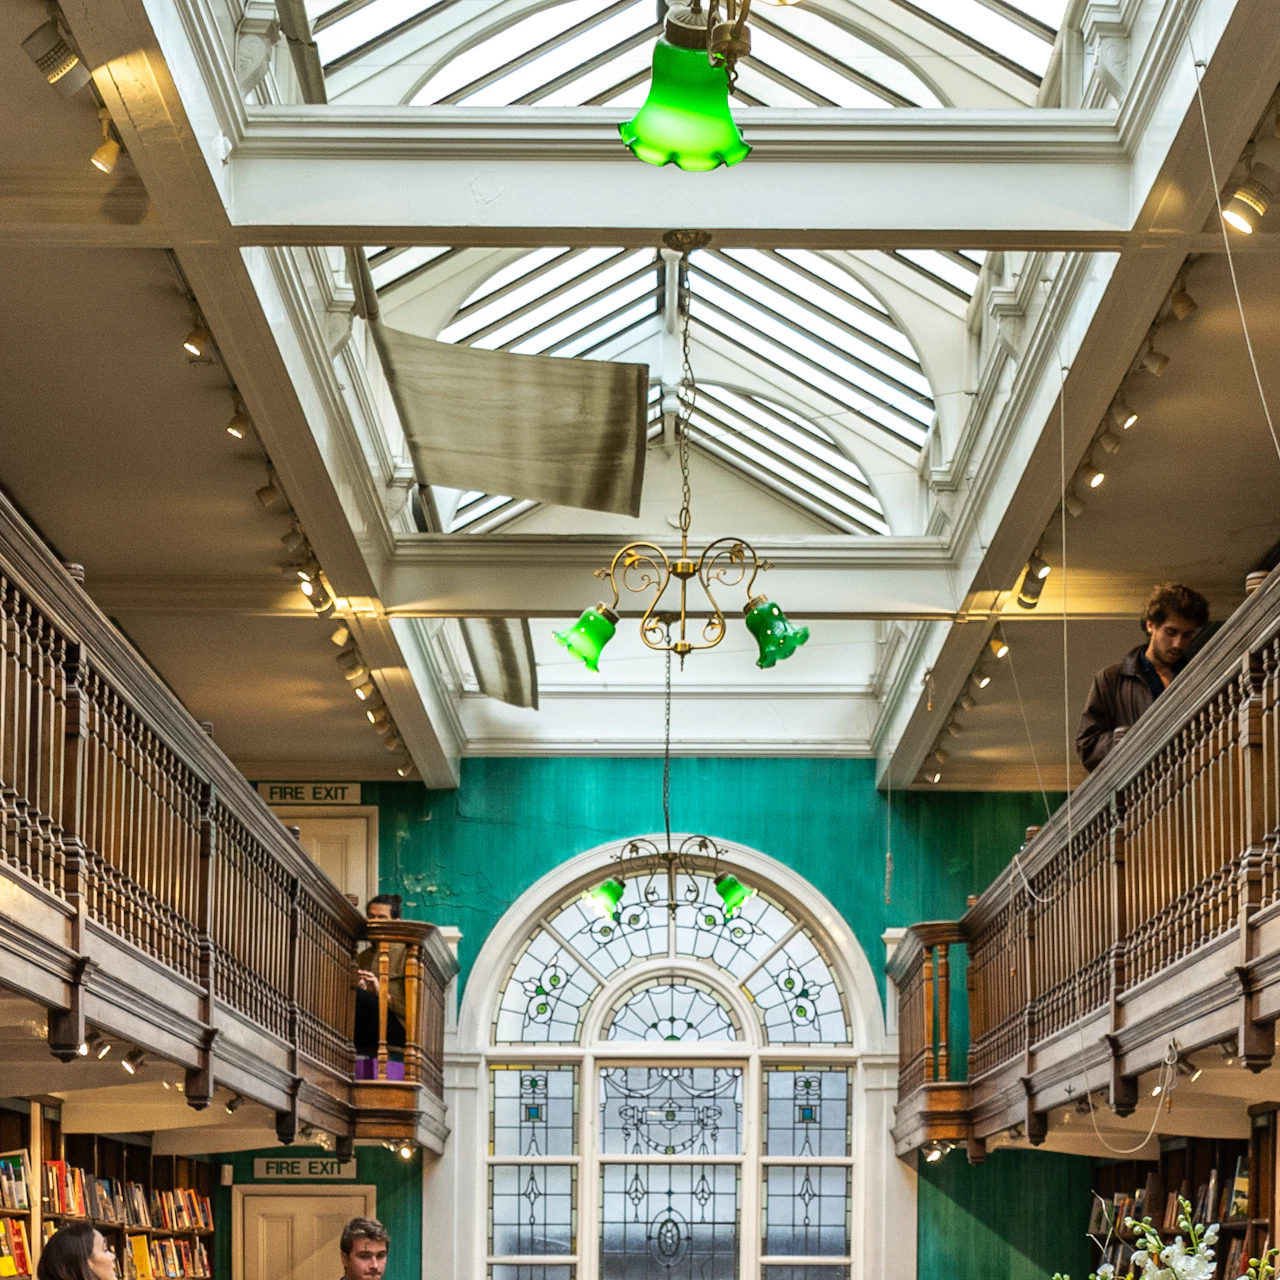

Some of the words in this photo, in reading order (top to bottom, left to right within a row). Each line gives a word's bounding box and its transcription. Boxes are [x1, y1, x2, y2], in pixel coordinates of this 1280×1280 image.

[269, 786, 304, 800] FIRE
[312, 786, 349, 800] EXIT
[265, 1160, 300, 1175] FIRE
[308, 1160, 342, 1175] EXIT
